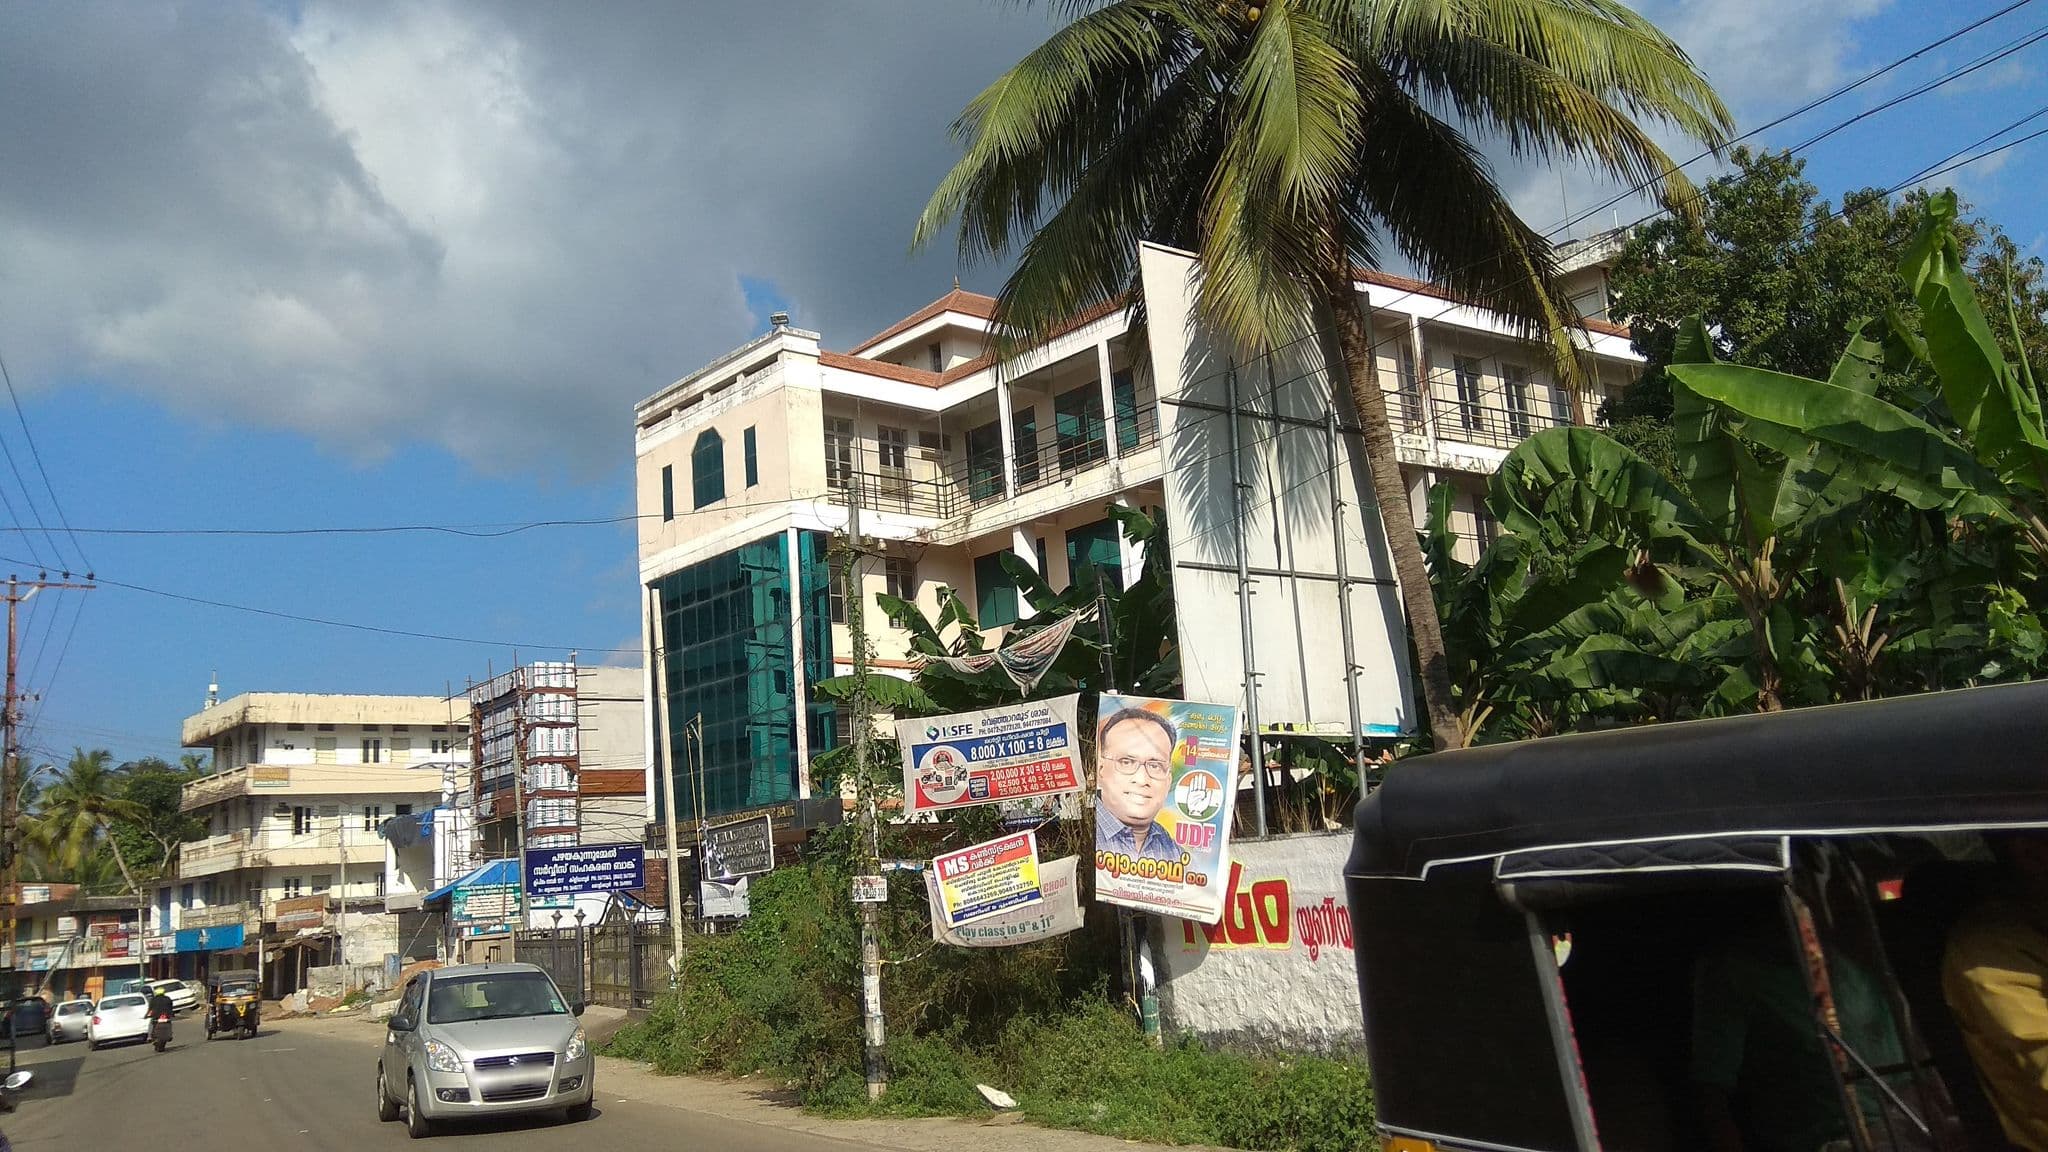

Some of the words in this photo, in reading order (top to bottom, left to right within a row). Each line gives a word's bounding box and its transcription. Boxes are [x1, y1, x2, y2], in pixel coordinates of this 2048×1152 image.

[943, 724, 973, 738] KSFE
[971, 745, 996, 761] 8,000
[998, 743, 1007, 757] X
[1008, 740, 1026, 755] 100
[1037, 738, 1044, 750] 8
[1186, 745, 1197, 757] 14
[1019, 767, 1025, 776] X
[1026, 765, 1035, 775] 30
[1042, 763, 1051, 774] 60
[1028, 775, 1037, 784] 40
[1044, 773, 1053, 781] 25
[1030, 782, 1039, 792] 40
[1175, 822, 1216, 848] UDF
[569, 862, 612, 874] സഹകരണ
[944, 854, 970, 877] MS
[1096, 850, 1191, 883] ശ്യാംനാഥ്
[978, 925, 1006, 938] class
[1007, 924, 1018, 936] to
[1032, 923, 1039, 932] &
